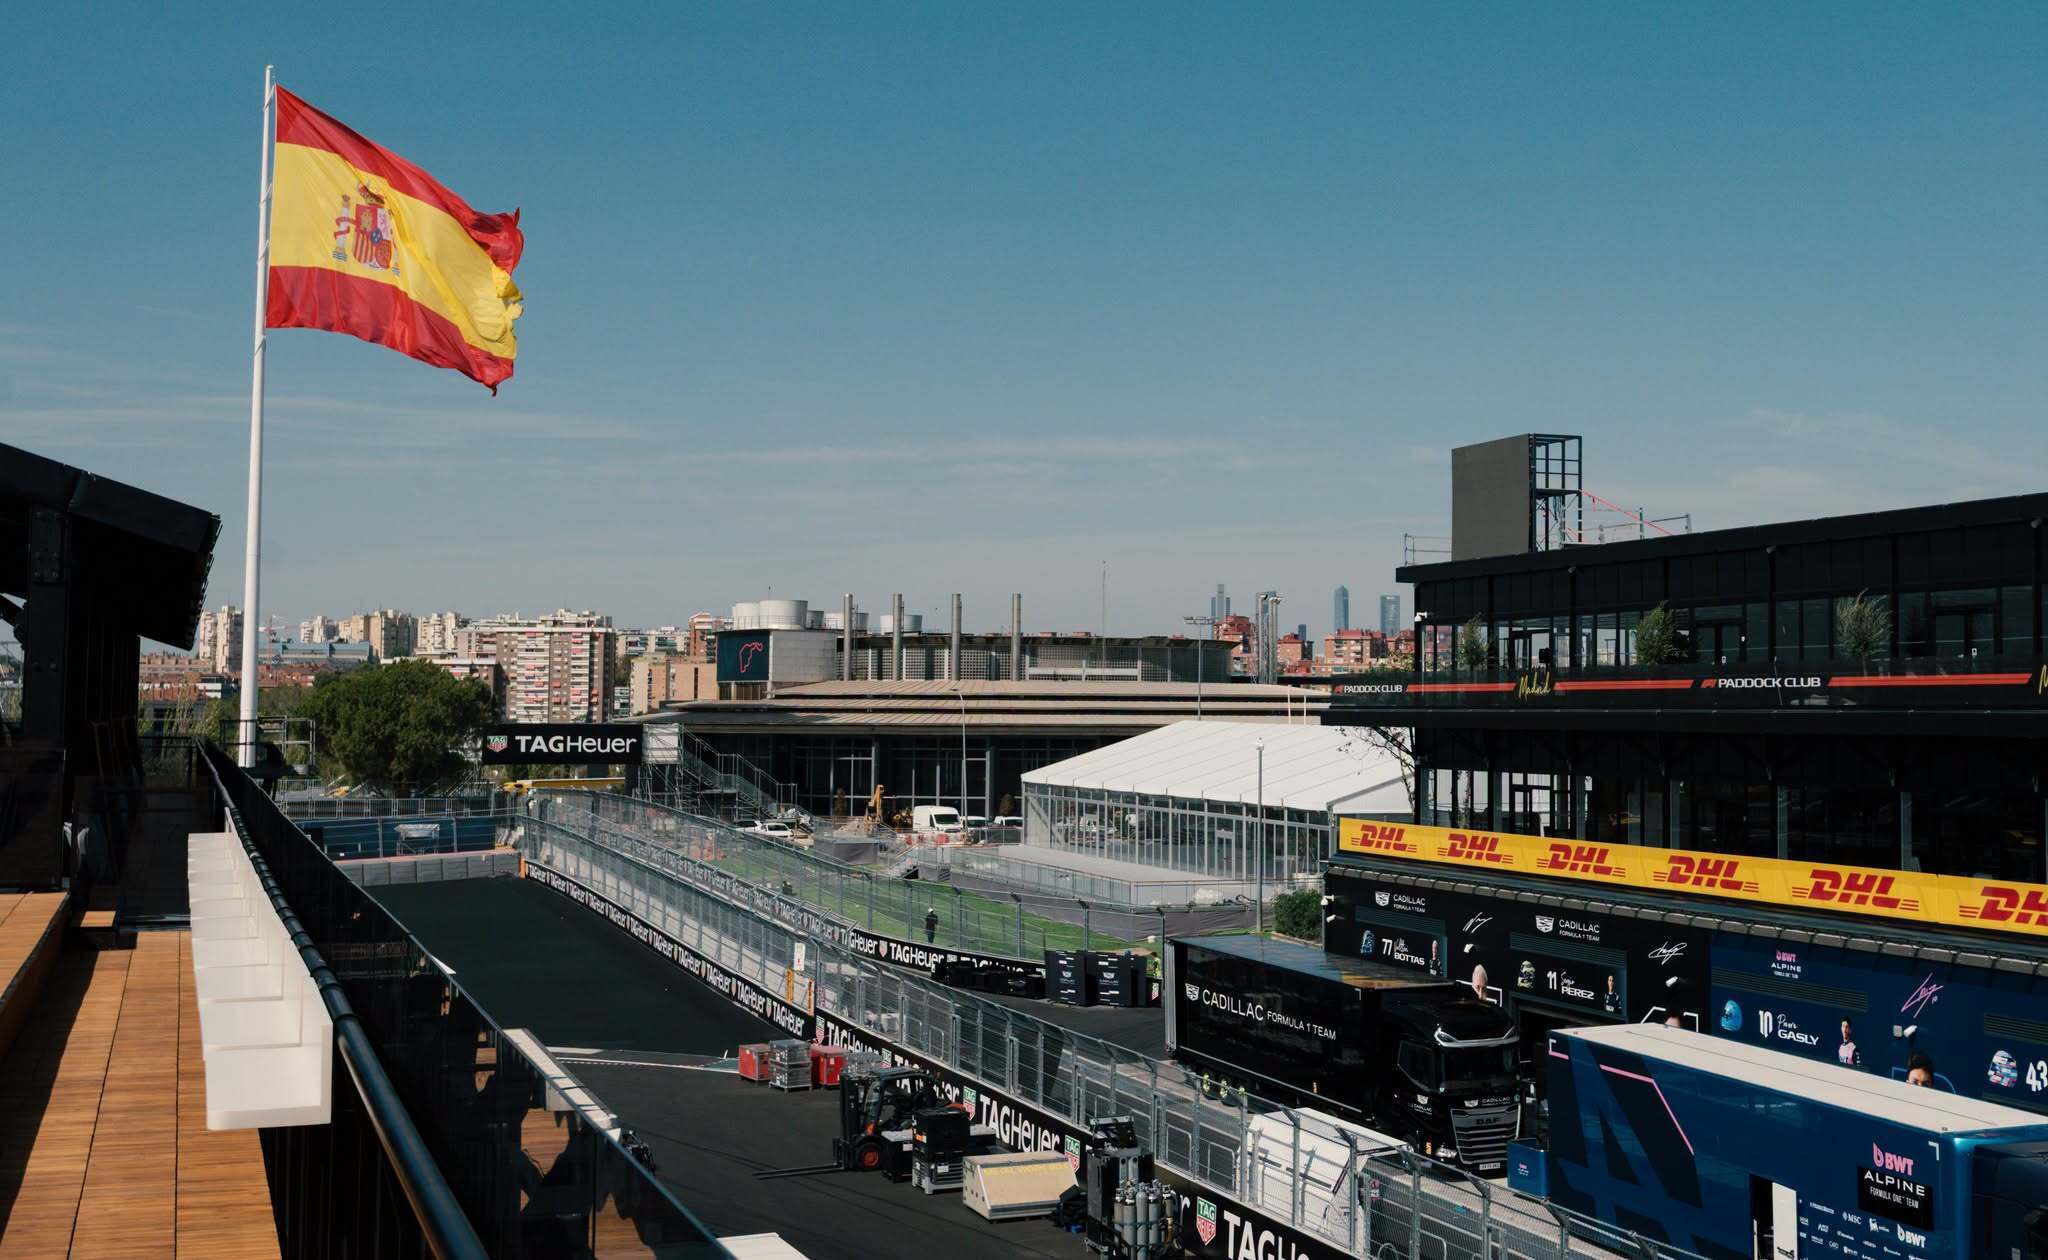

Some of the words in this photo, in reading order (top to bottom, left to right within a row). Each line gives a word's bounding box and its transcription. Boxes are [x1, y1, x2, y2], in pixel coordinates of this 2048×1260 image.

[1344, 685, 1381, 693] PADDOCK
[1381, 684, 1402, 693] CLUB
[1518, 671, 1551, 702] Madrid
[1718, 678, 1782, 688] PADDOCK
[1784, 677, 1821, 688] CLUB
[515, 735, 637, 753] TAGHeuer
[1360, 824, 1408, 851] DHL
[1447, 834, 1503, 862] DHL
[1549, 843, 1613, 875] DHL
[1667, 855, 1744, 891] DHL
[1809, 869, 1902, 909] DHL
[1393, 894, 1426, 906] CADILLAC
[1979, 886, 2048, 928] DH
[1559, 919, 1600, 933] CADILLAC
[1559, 929, 1581, 938] FORMULA
[1586, 934, 1600, 942] TEAM
[1382, 938, 1393, 956] 77
[1394, 952, 1425, 966] BOTTAS
[1771, 962, 1802, 972] ALPINE
[1547, 970, 1557, 990] 11
[1561, 986, 1595, 999] PEREZ
[1202, 989, 1264, 1021] CADILLAC
[1267, 1011, 1304, 1031] FORMULA
[1306, 1022, 1311, 1033] 1
[1312, 1024, 1336, 1041] TEAM
[1777, 1029, 1819, 1046] GASLY
[2026, 1060, 2048, 1092] 43
[979, 1094, 1060, 1153] TAGHeuer
[1476, 1117, 1499, 1125] DAF
[1066, 1138, 1080, 1154] TAG
[1885, 1152, 1914, 1176] BWT
[1864, 1170, 1925, 1196] ALPINE
[1869, 1186, 1891, 1200] FORMULA
[1906, 1197, 1919, 1208] TEAM
[1198, 1201, 1216, 1220] TAG
[1848, 1212, 1862, 1225] MSC
[1905, 1229, 1926, 1248] BWT
